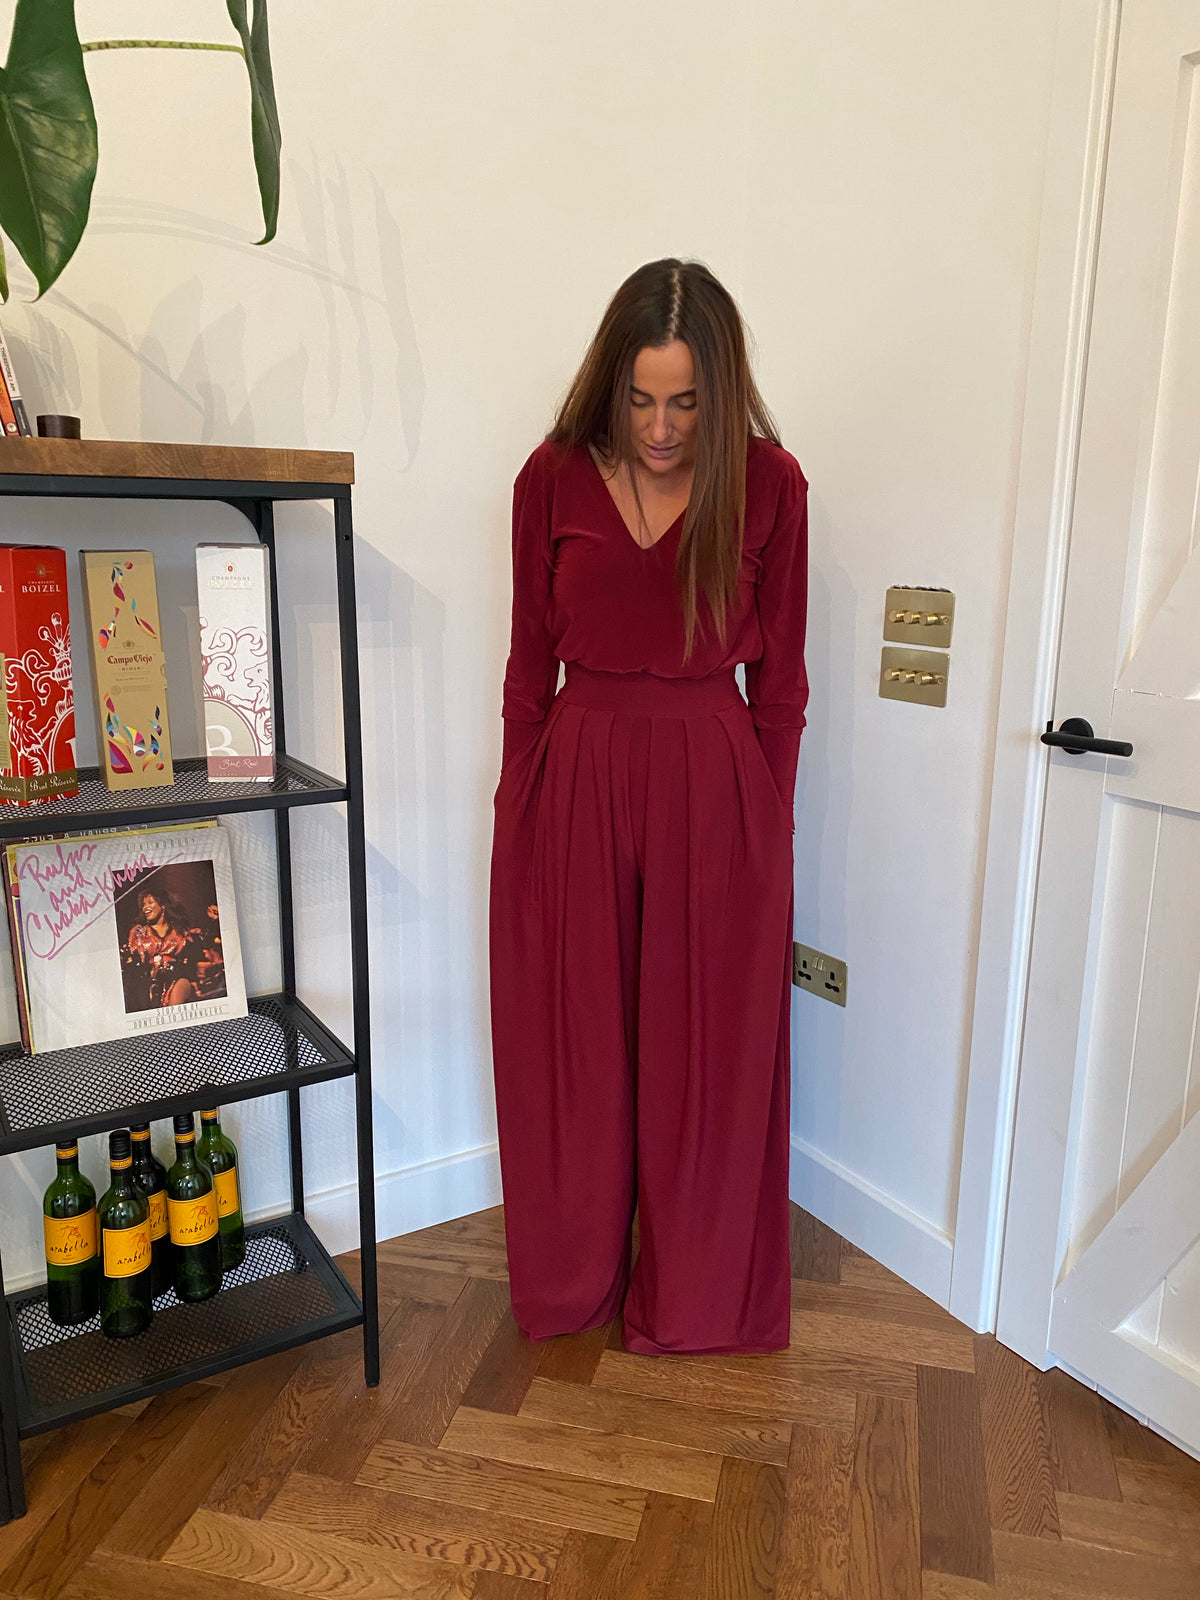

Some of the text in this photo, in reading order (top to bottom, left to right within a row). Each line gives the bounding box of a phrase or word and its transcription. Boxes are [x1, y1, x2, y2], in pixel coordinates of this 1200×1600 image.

[21, 584, 61, 593] BOIZEL
[107, 653, 153, 666] Campo Viejo
[179, 1218, 215, 1234] arabella
[50, 1240, 88, 1254] arabella
